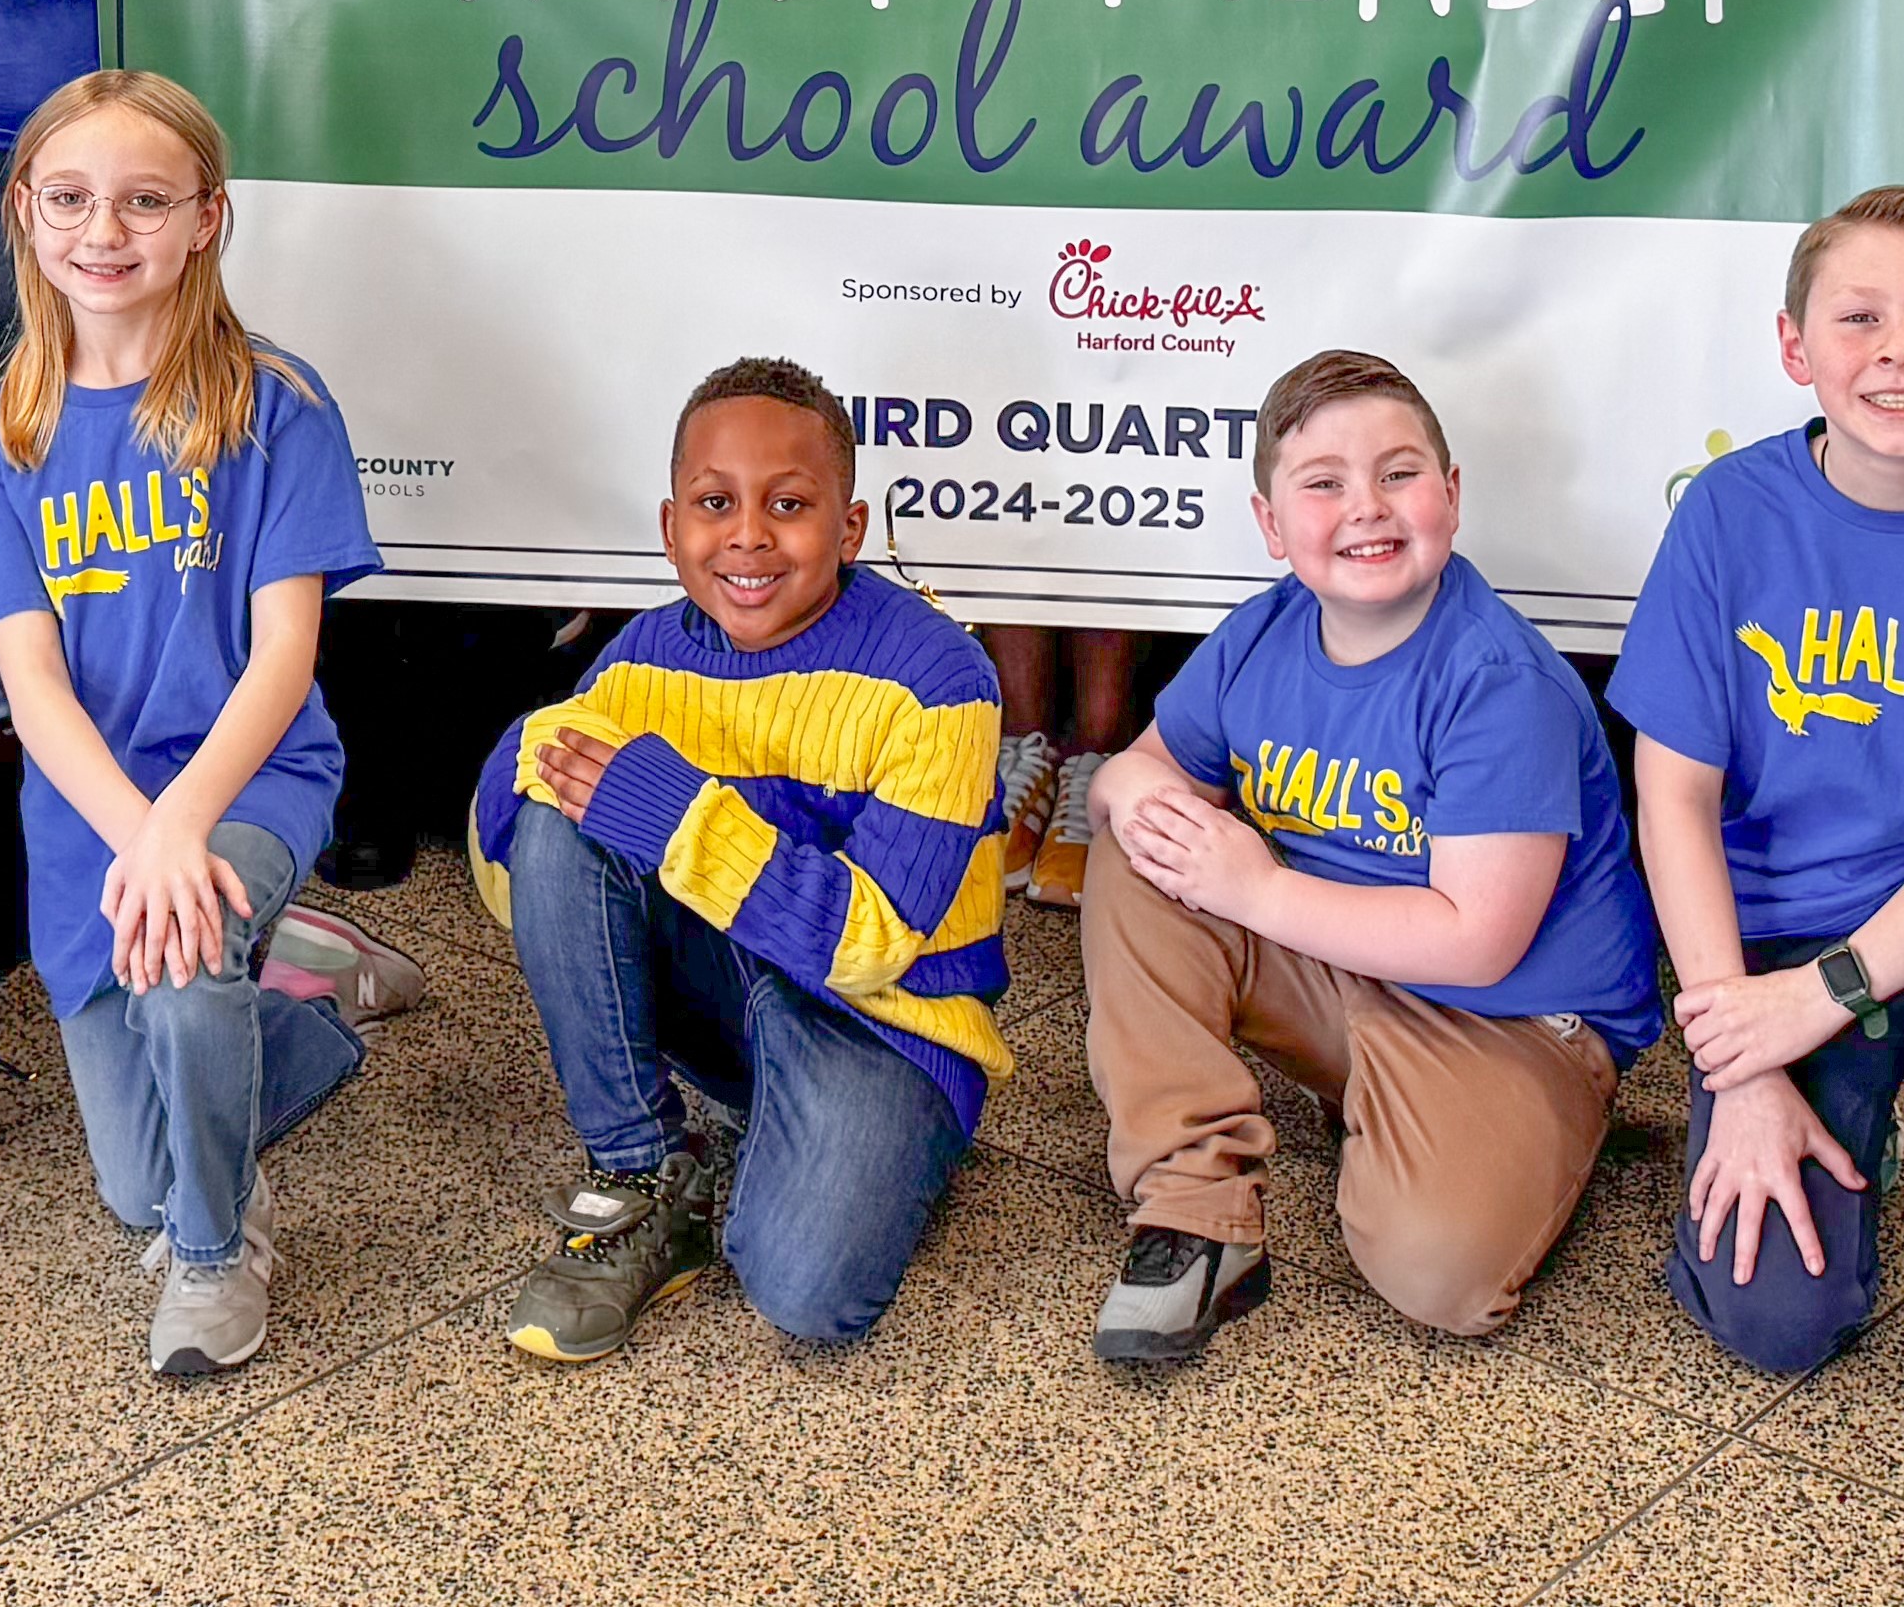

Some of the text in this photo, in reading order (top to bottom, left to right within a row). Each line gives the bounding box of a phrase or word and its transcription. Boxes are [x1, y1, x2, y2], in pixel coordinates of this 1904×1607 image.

[841, 278, 1022, 309] Sponsored by
[1076, 331, 1237, 358] Harford County
[838, 395, 1258, 461] IRD QUART
[354, 456, 456, 477] COUNTY
[40, 466, 211, 570] HALL'S
[895, 476, 1206, 530] 2024-2025
[1256, 738, 1411, 833] HALL'S
